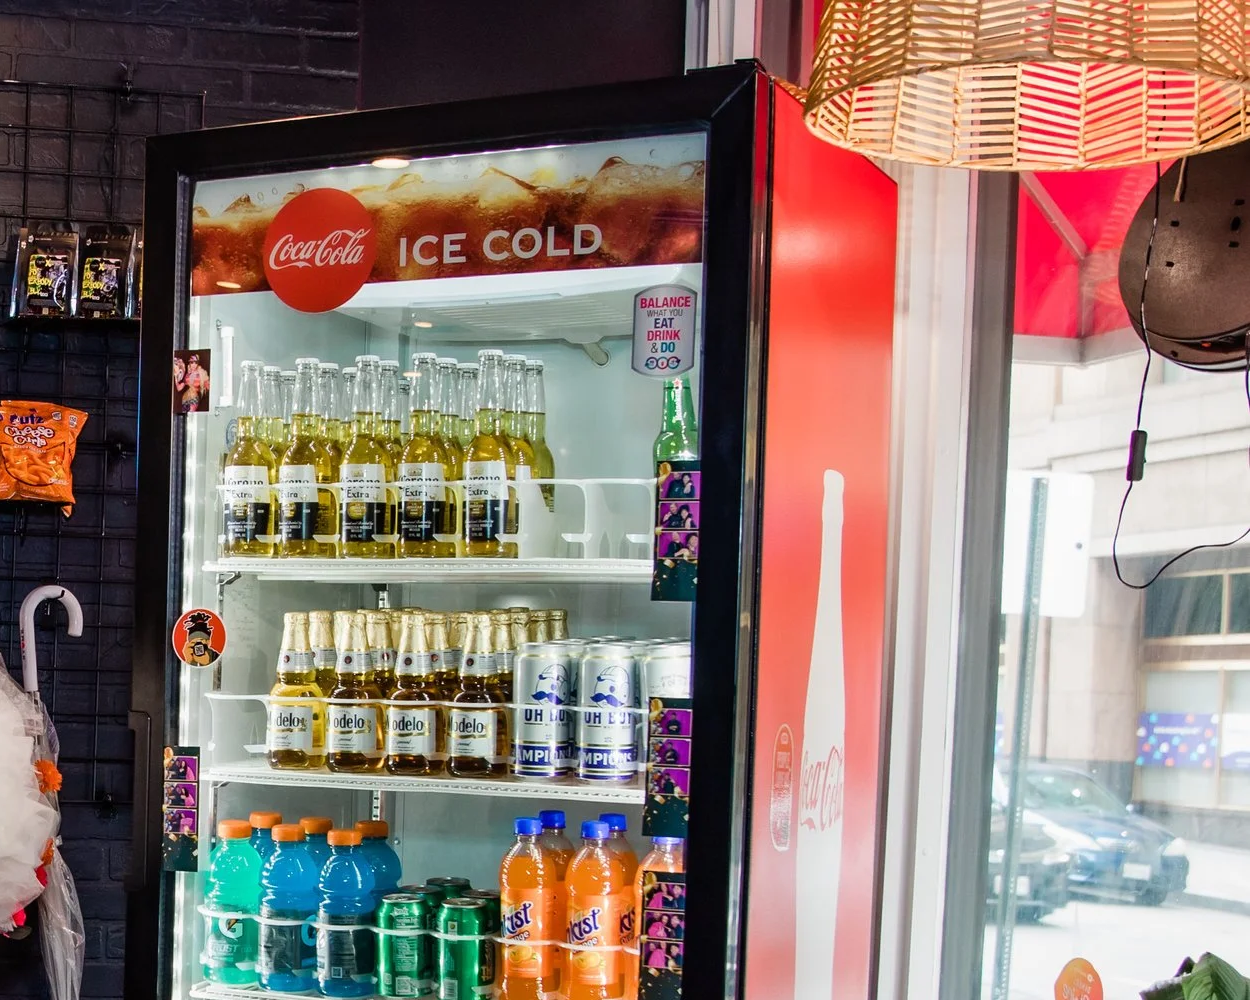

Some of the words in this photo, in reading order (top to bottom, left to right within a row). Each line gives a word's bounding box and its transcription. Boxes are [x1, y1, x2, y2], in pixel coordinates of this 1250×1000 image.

[268, 228, 371, 270] Coca-Cola
[399, 232, 467, 267] ICE
[482, 223, 603, 261] COLD
[640, 296, 691, 309] BALANCE
[646, 309, 667, 317] WHAT
[669, 308, 683, 317] YOU
[654, 317, 674, 329] EAT
[647, 329, 680, 341] DRINK
[650, 342, 658, 353] &
[660, 342, 676, 353] DO
[4, 425, 55, 438] Cheese
[13, 435, 47, 447] Curls
[347, 489, 370, 499] Extra
[405, 487, 428, 497] Extra
[270, 712, 299, 729] delo
[328, 713, 365, 729] odelo
[218, 911, 244, 940] G
